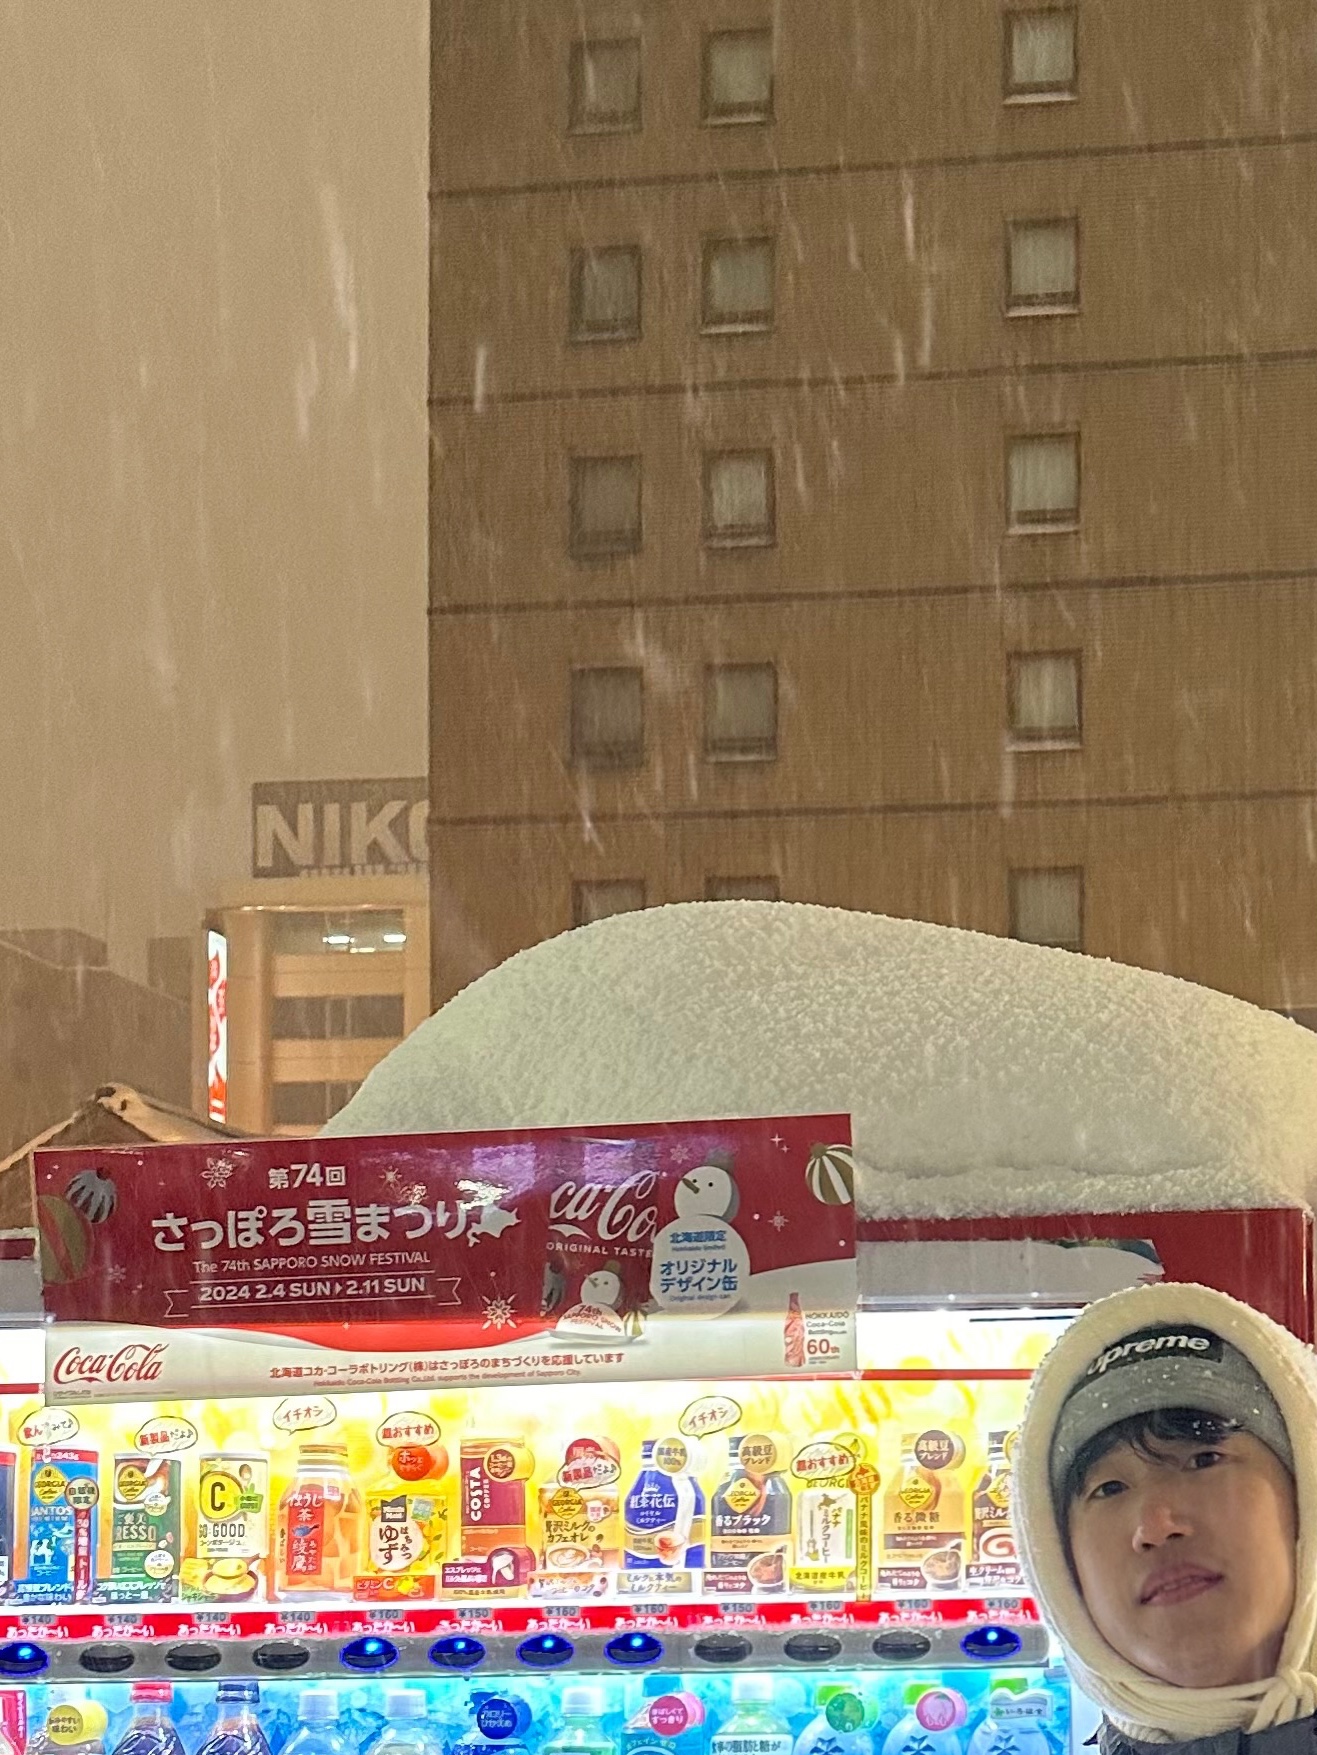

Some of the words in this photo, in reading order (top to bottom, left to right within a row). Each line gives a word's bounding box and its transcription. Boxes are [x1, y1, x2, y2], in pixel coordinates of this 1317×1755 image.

[268, 1163, 346, 1190] 第74回
[151, 1197, 466, 1252] さっぽろ雪まつり
[545, 1242, 609, 1257] ORIGINAL
[192, 1260, 218, 1274] The
[220, 1258, 251, 1272] 74th
[253, 1256, 318, 1272] SAPPORO
[320, 1253, 367, 1268] SNOW
[369, 1250, 431, 1266] FESTIVAL
[659, 1258, 738, 1276] オリジナル
[198, 1285, 251, 1302] 2024
[254, 1283, 288, 1300] 2.4
[288, 1280, 332, 1298] SUN
[346, 1280, 380, 1296] 2.11
[383, 1276, 426, 1294] SUN
[659, 1275, 739, 1294] デザイン缶
[53, 1343, 170, 1385] Coca-Cola
[282, 1406, 324, 1422] イチオシ
[688, 1407, 729, 1428] イチオシ
[743, 1456, 771, 1466] ブレンド
[210, 1481, 226, 1512] C
[469, 1466, 482, 1522] COSTA
[629, 1494, 676, 1509] 紅茶花伝
[715, 1514, 771, 1528] 香るブラック
[378, 1526, 399, 1565] ゆず
[399, 1527, 413, 1560] はちみつ
[546, 1533, 589, 1543] カフェオレ
[458, 1608, 489, 1618] ¥150
